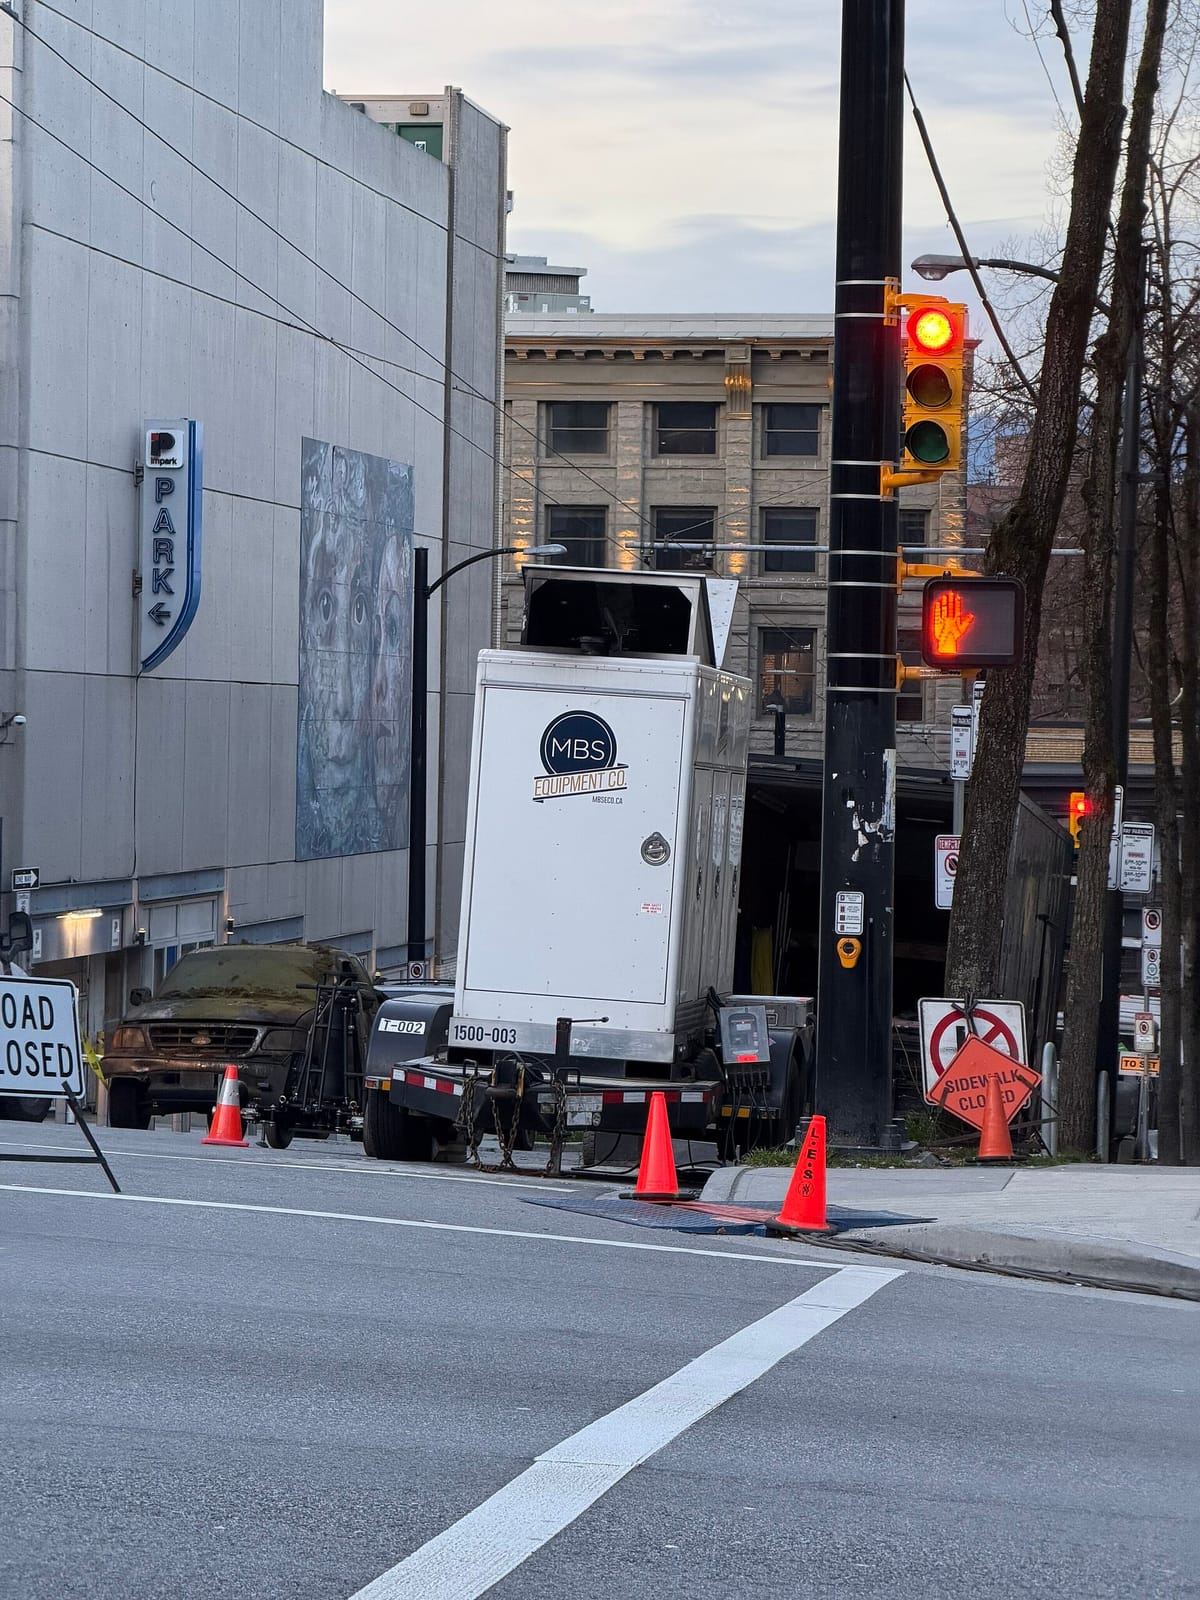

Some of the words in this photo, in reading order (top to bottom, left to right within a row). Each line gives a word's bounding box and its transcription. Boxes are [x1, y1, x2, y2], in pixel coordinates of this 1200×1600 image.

[150, 456, 177, 466] impark
[152, 476, 176, 594] PARK
[551, 737, 605, 761] MBS
[534, 772, 605, 796] EQUIPMENT
[608, 769, 628, 788] CO.
[1, 992, 55, 1031] OAD
[383, 1020, 423, 1034] T-002
[454, 1024, 517, 1045] 1500-003
[0, 1039, 74, 1078] OSED
[1123, 1059, 1137, 1068] TO
